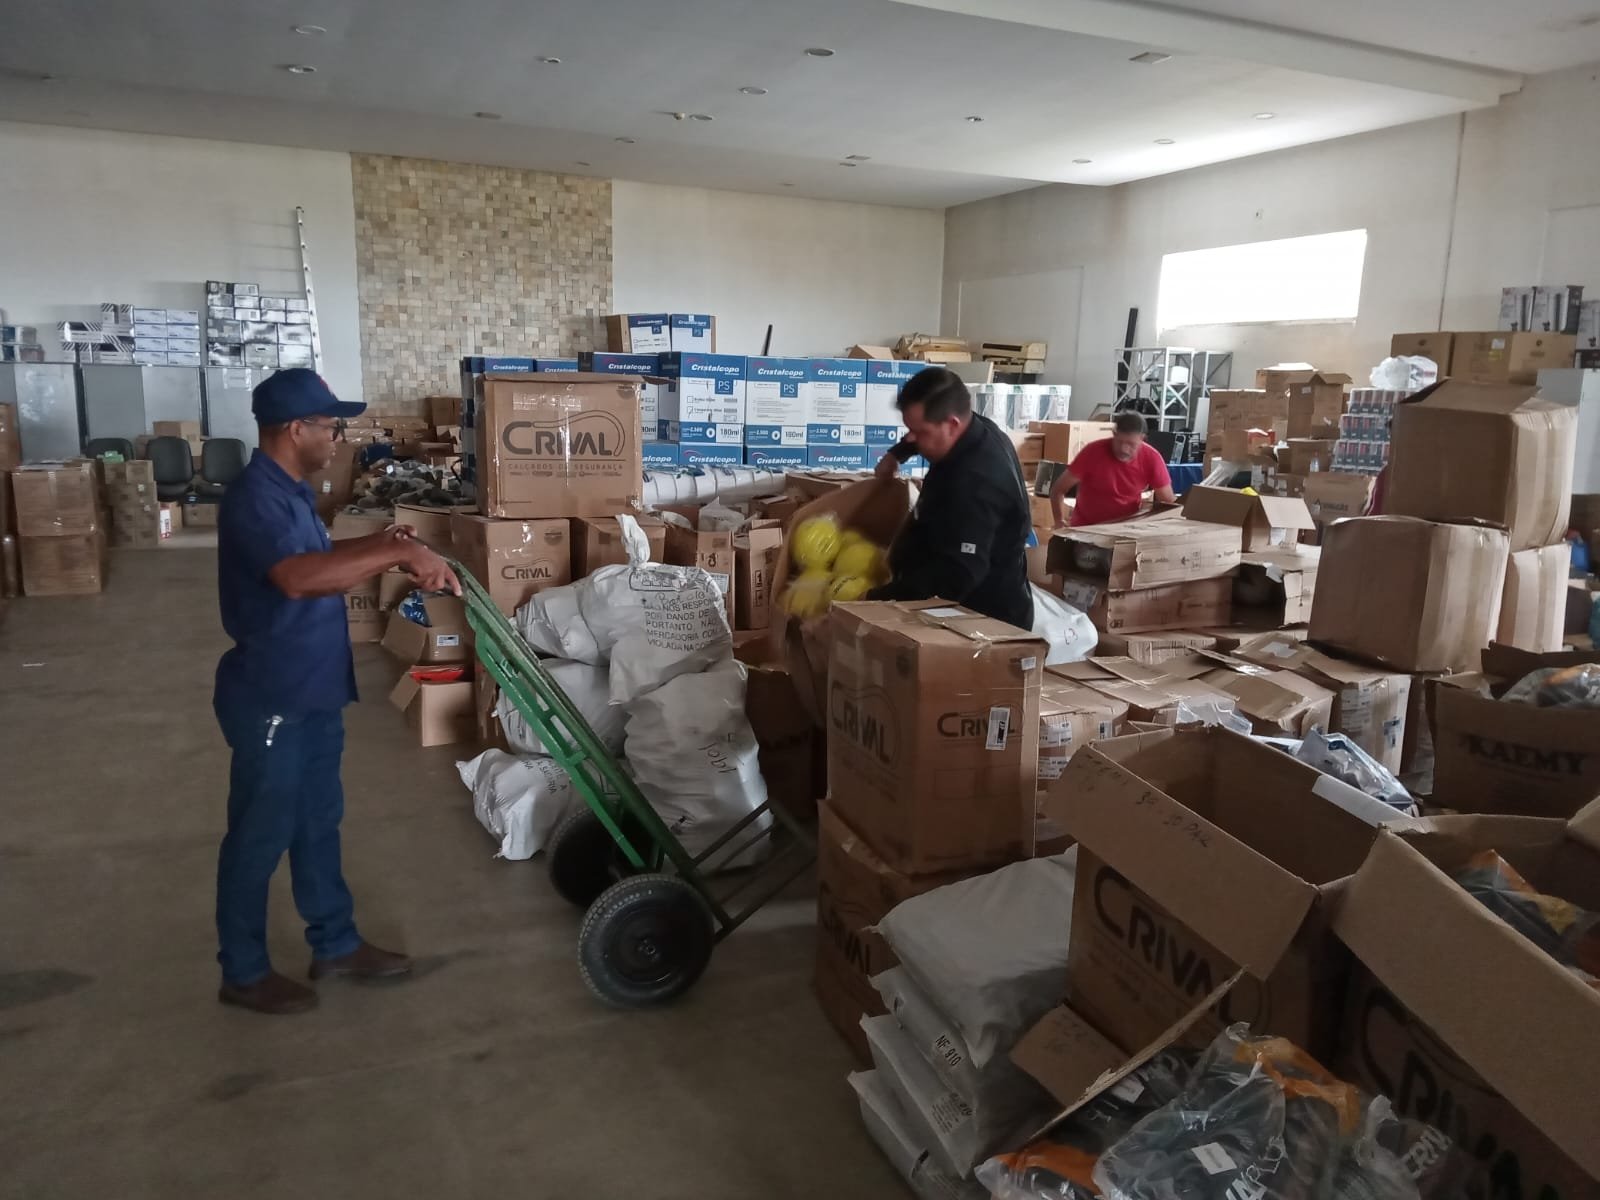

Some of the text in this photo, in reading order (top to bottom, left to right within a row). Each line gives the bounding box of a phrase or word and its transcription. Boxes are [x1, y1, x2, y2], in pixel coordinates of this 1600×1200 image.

[608, 363, 652, 371] Cristalcopo
[691, 364, 740, 373] Cristalcopo
[758, 368, 804, 377] Cristalcopo
[817, 368, 862, 377] Cristalcopo
[718, 380, 730, 391] PS
[783, 384, 795, 394] PS
[842, 384, 853, 394] PS
[720, 428, 740, 436] 180ml
[502, 421, 613, 456] CRIVAL
[642, 455, 672, 463] alcopo
[689, 455, 737, 463] Cristalcopo
[817, 455, 862, 463] Cristalcopo
[501, 564, 552, 580] CRIVAL
[666, 611, 695, 621] DANOS
[831, 679, 891, 764] CRIVAL
[936, 711, 1016, 738] CRIVL
[935, 1034, 963, 1068] NF 910
